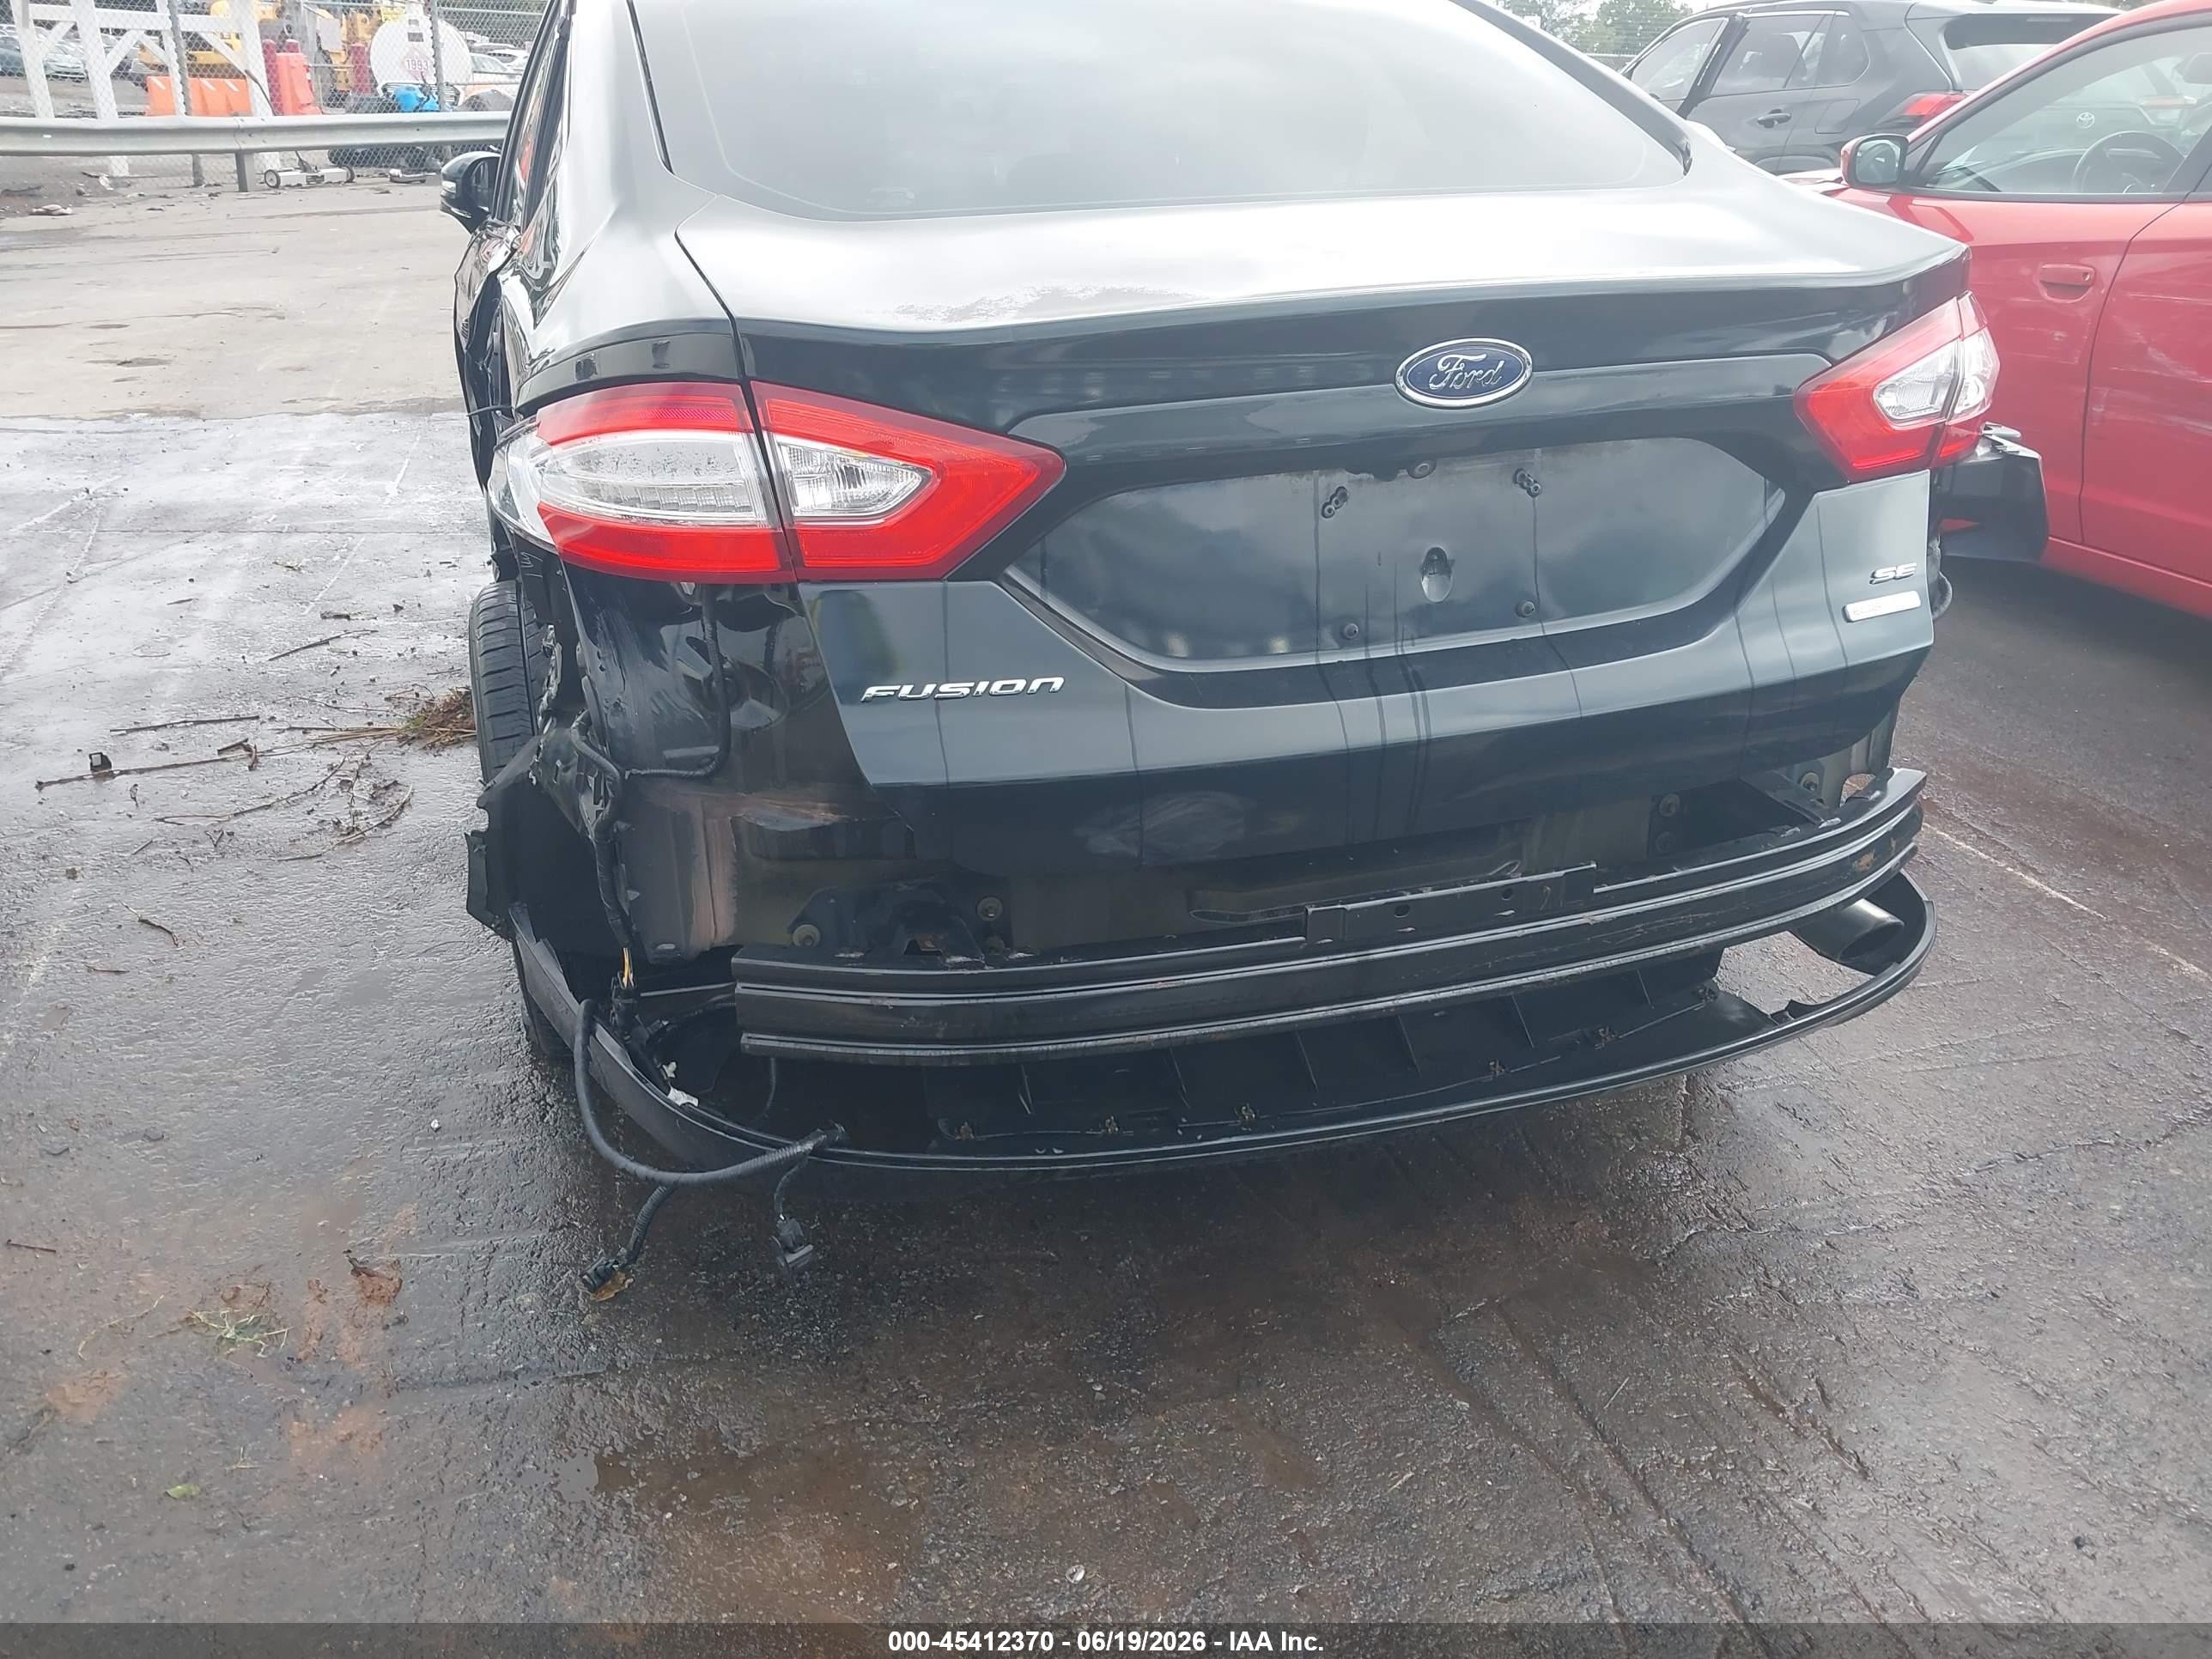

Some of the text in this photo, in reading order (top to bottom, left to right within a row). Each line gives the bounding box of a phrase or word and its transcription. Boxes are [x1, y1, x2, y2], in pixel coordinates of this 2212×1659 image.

[406, 59, 428, 70] 1993
[1428, 353, 1505, 390] Ford
[1869, 562, 1917, 585] SE
[860, 676, 1065, 702] FUSION
